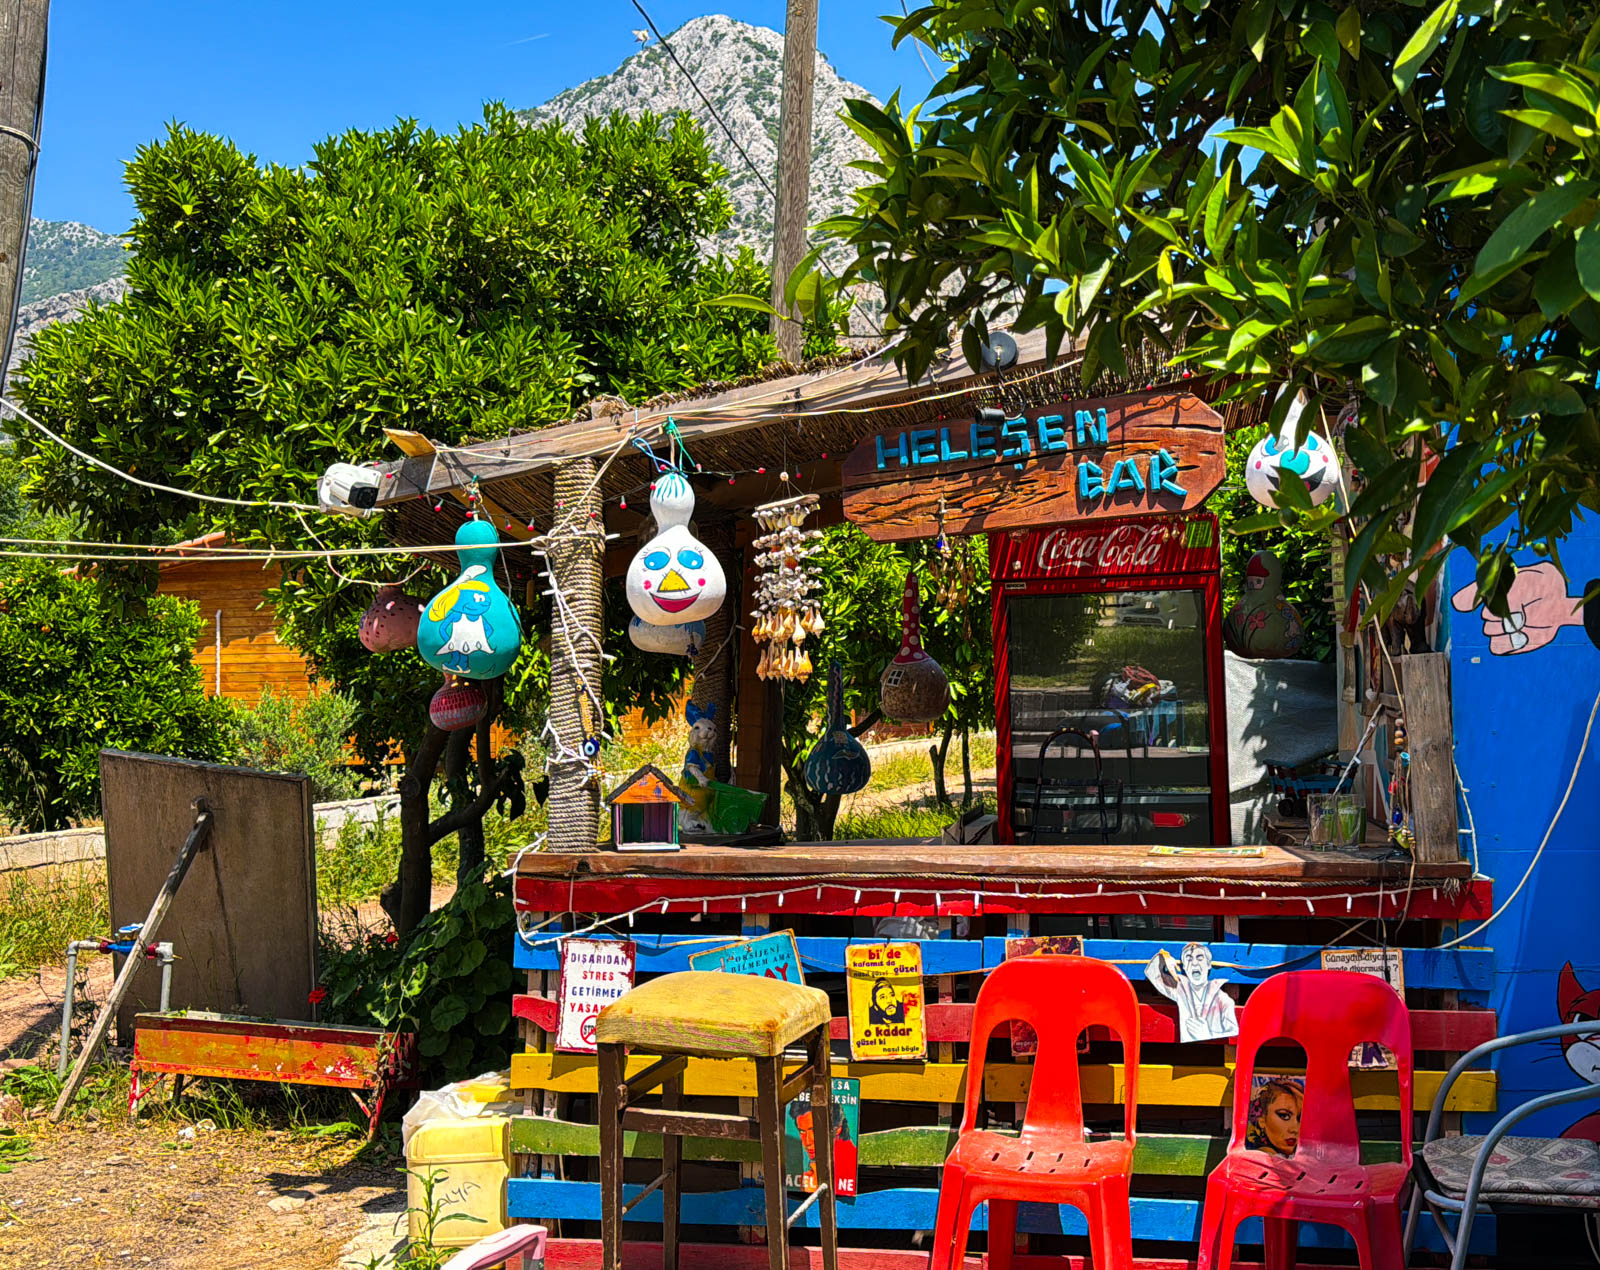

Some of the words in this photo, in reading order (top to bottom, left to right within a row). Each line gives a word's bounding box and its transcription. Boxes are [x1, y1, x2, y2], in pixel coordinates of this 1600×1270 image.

[1077, 447, 1188, 499] BAR
[1036, 523, 1166, 570] Coca-Cola
[570, 952, 628, 966] DIŞARIDAN
[886, 948, 901, 959] de
[1364, 952, 1398, 962] diyoum
[893, 964, 918, 975] güzel
[582, 970, 615, 981] STRES
[571, 986, 623, 998] GETİRMEK
[864, 1029, 872, 1038] o
[875, 1026, 913, 1037] kadar
[856, 1038, 877, 1048] güzel
